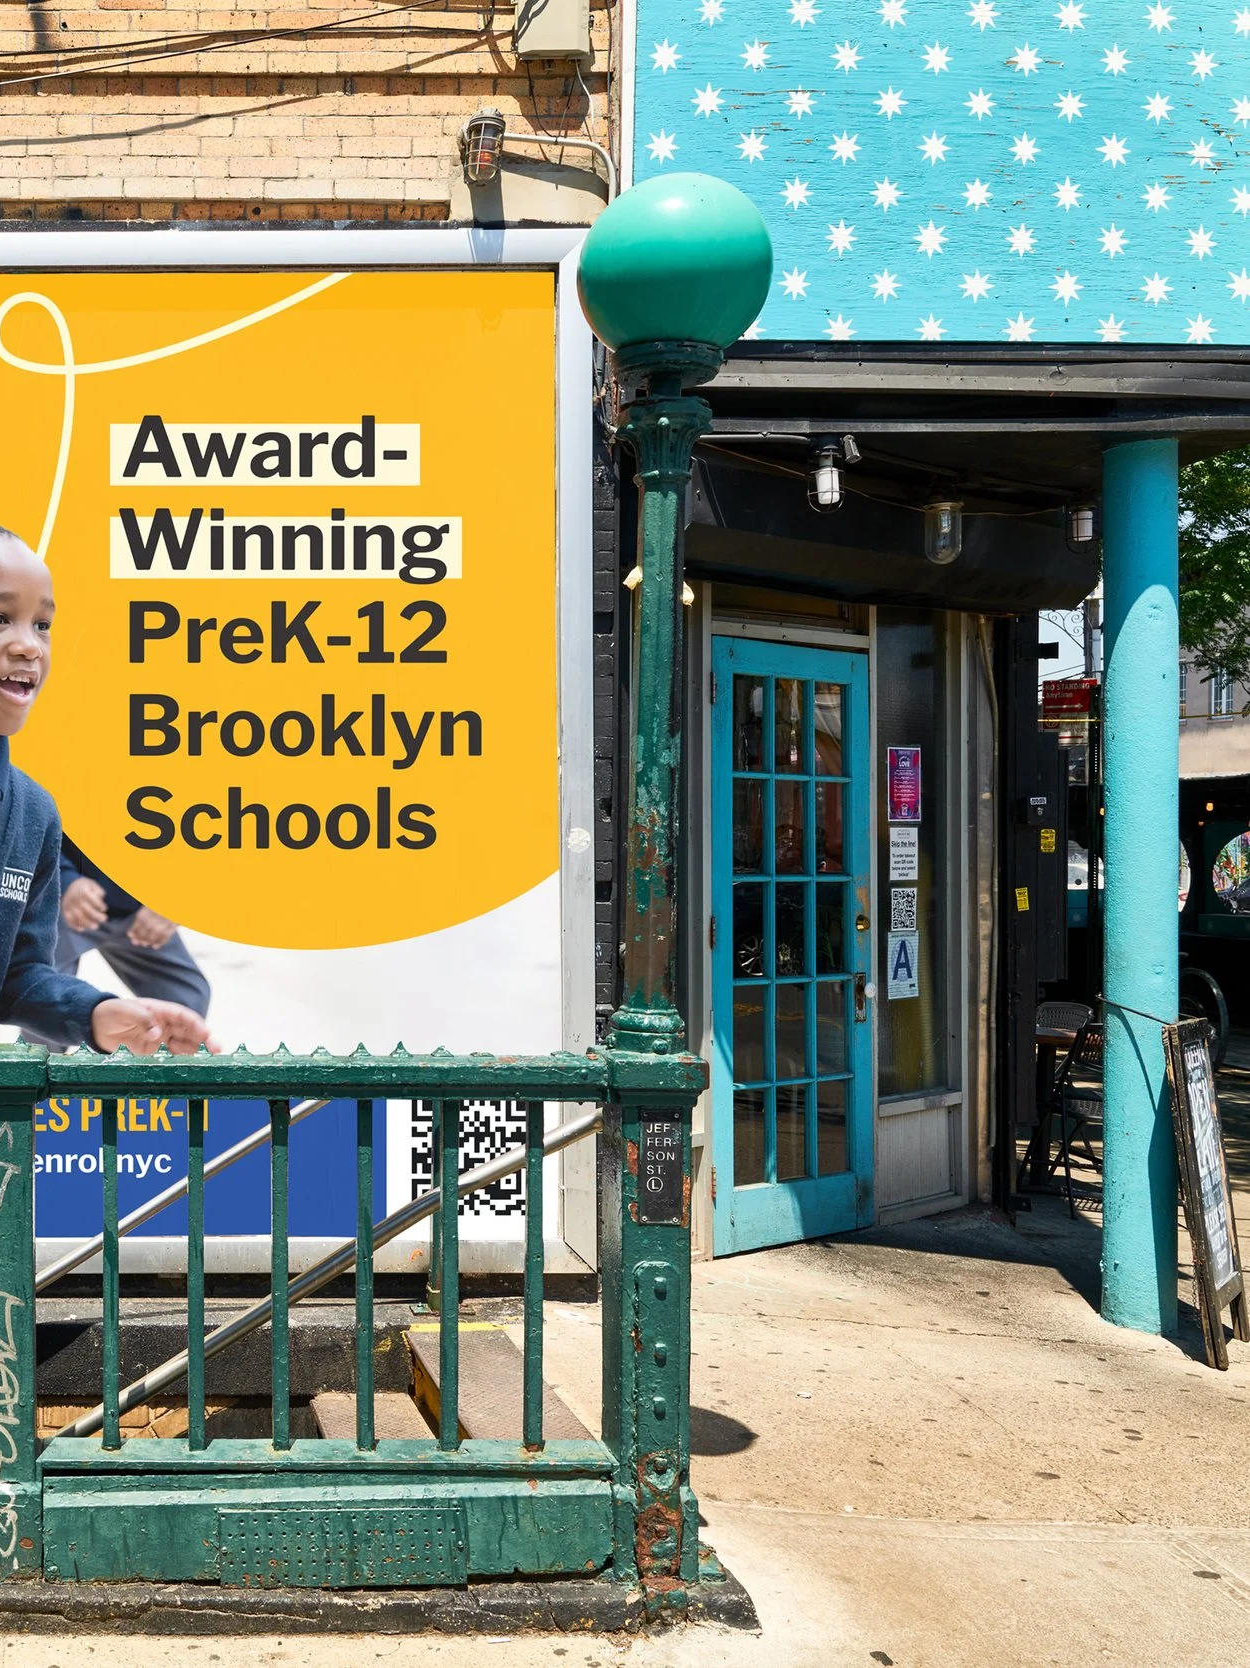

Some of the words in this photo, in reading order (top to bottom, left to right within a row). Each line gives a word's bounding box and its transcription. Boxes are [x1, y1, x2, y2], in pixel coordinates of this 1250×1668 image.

[123, 416, 407, 478] Award-
[119, 508, 449, 584] Winning
[130, 601, 447, 663] PreK-12
[130, 694, 481, 769] Brooklyn
[125, 786, 436, 849] Schools
[892, 940, 913, 980] A
[646, 1137, 677, 1147] FER-
[646, 1151, 675, 1161] SON
[646, 1165, 666, 1175] ST.
[651, 1180, 659, 1190] L
